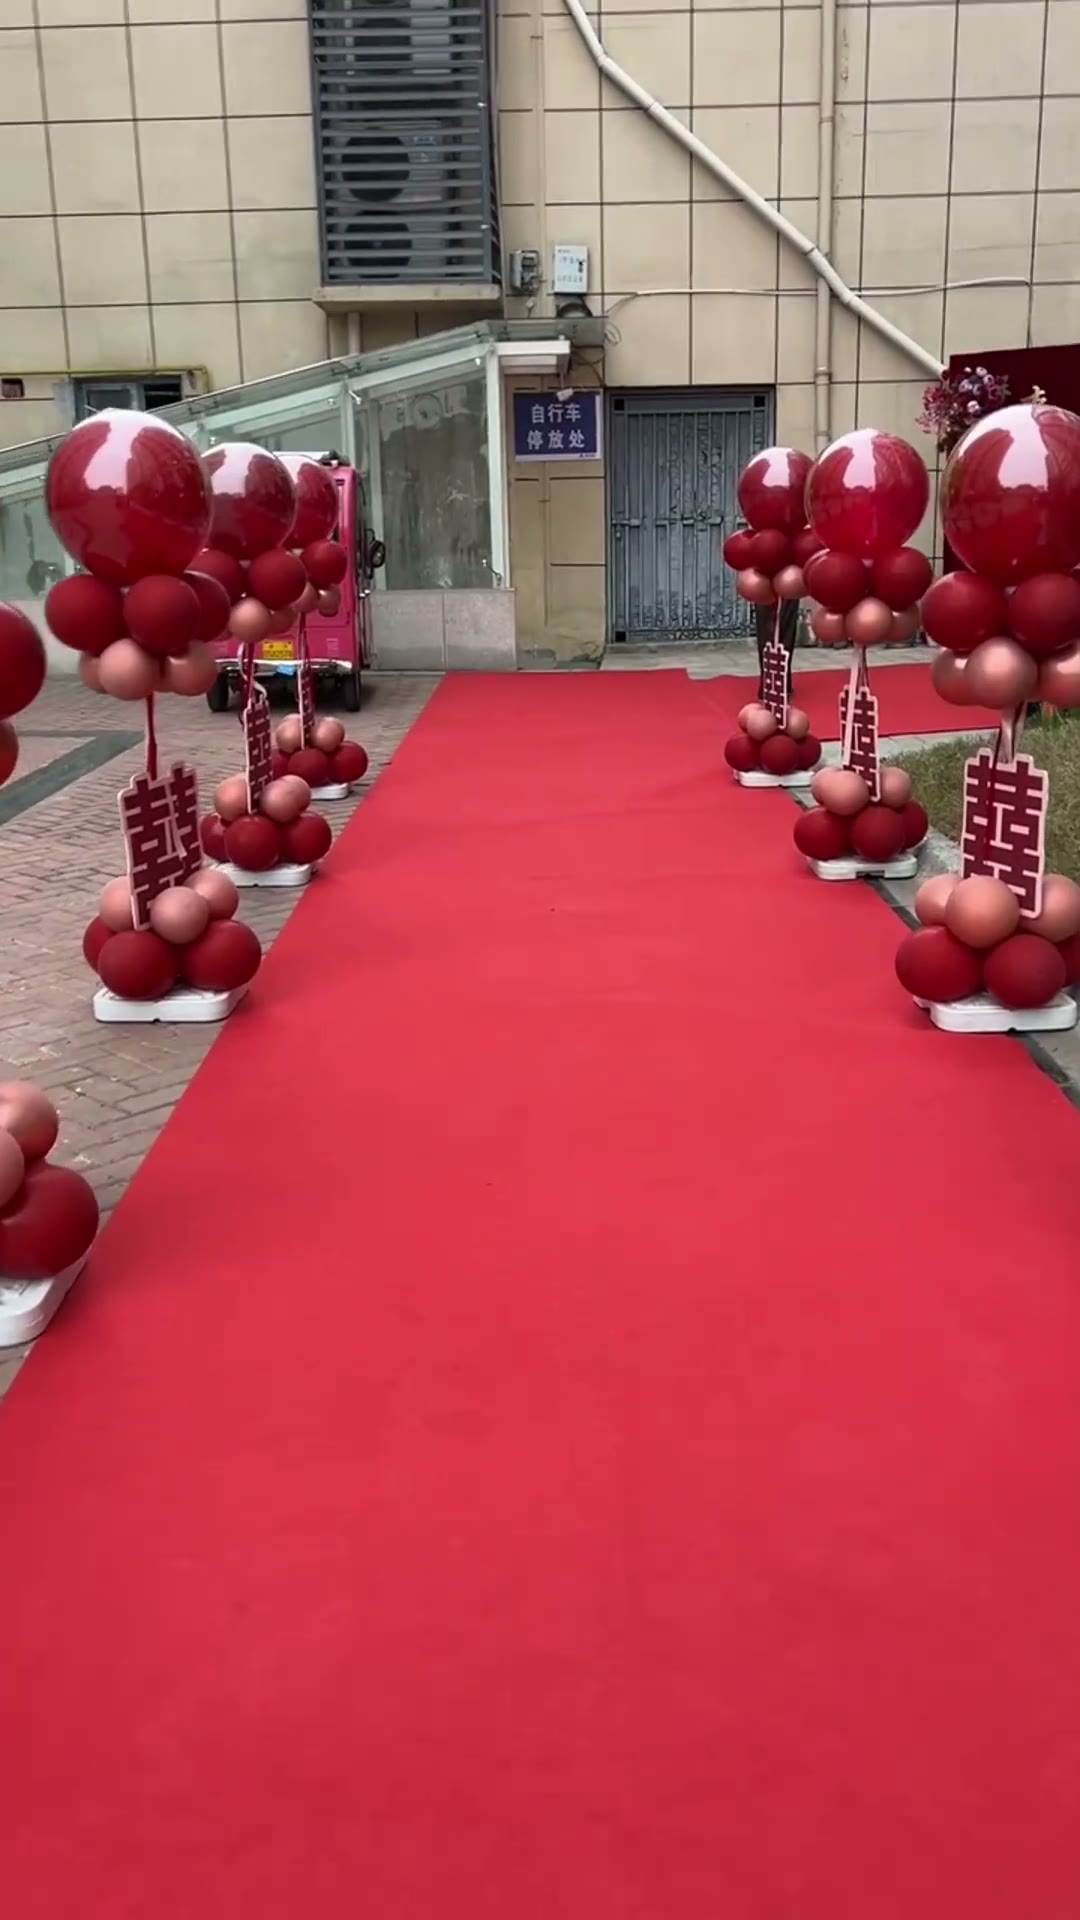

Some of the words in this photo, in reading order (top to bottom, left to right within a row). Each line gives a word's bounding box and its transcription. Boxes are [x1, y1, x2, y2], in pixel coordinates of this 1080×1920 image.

[531, 403, 581, 424] 自行车
[527, 429, 585, 450] 停放处
